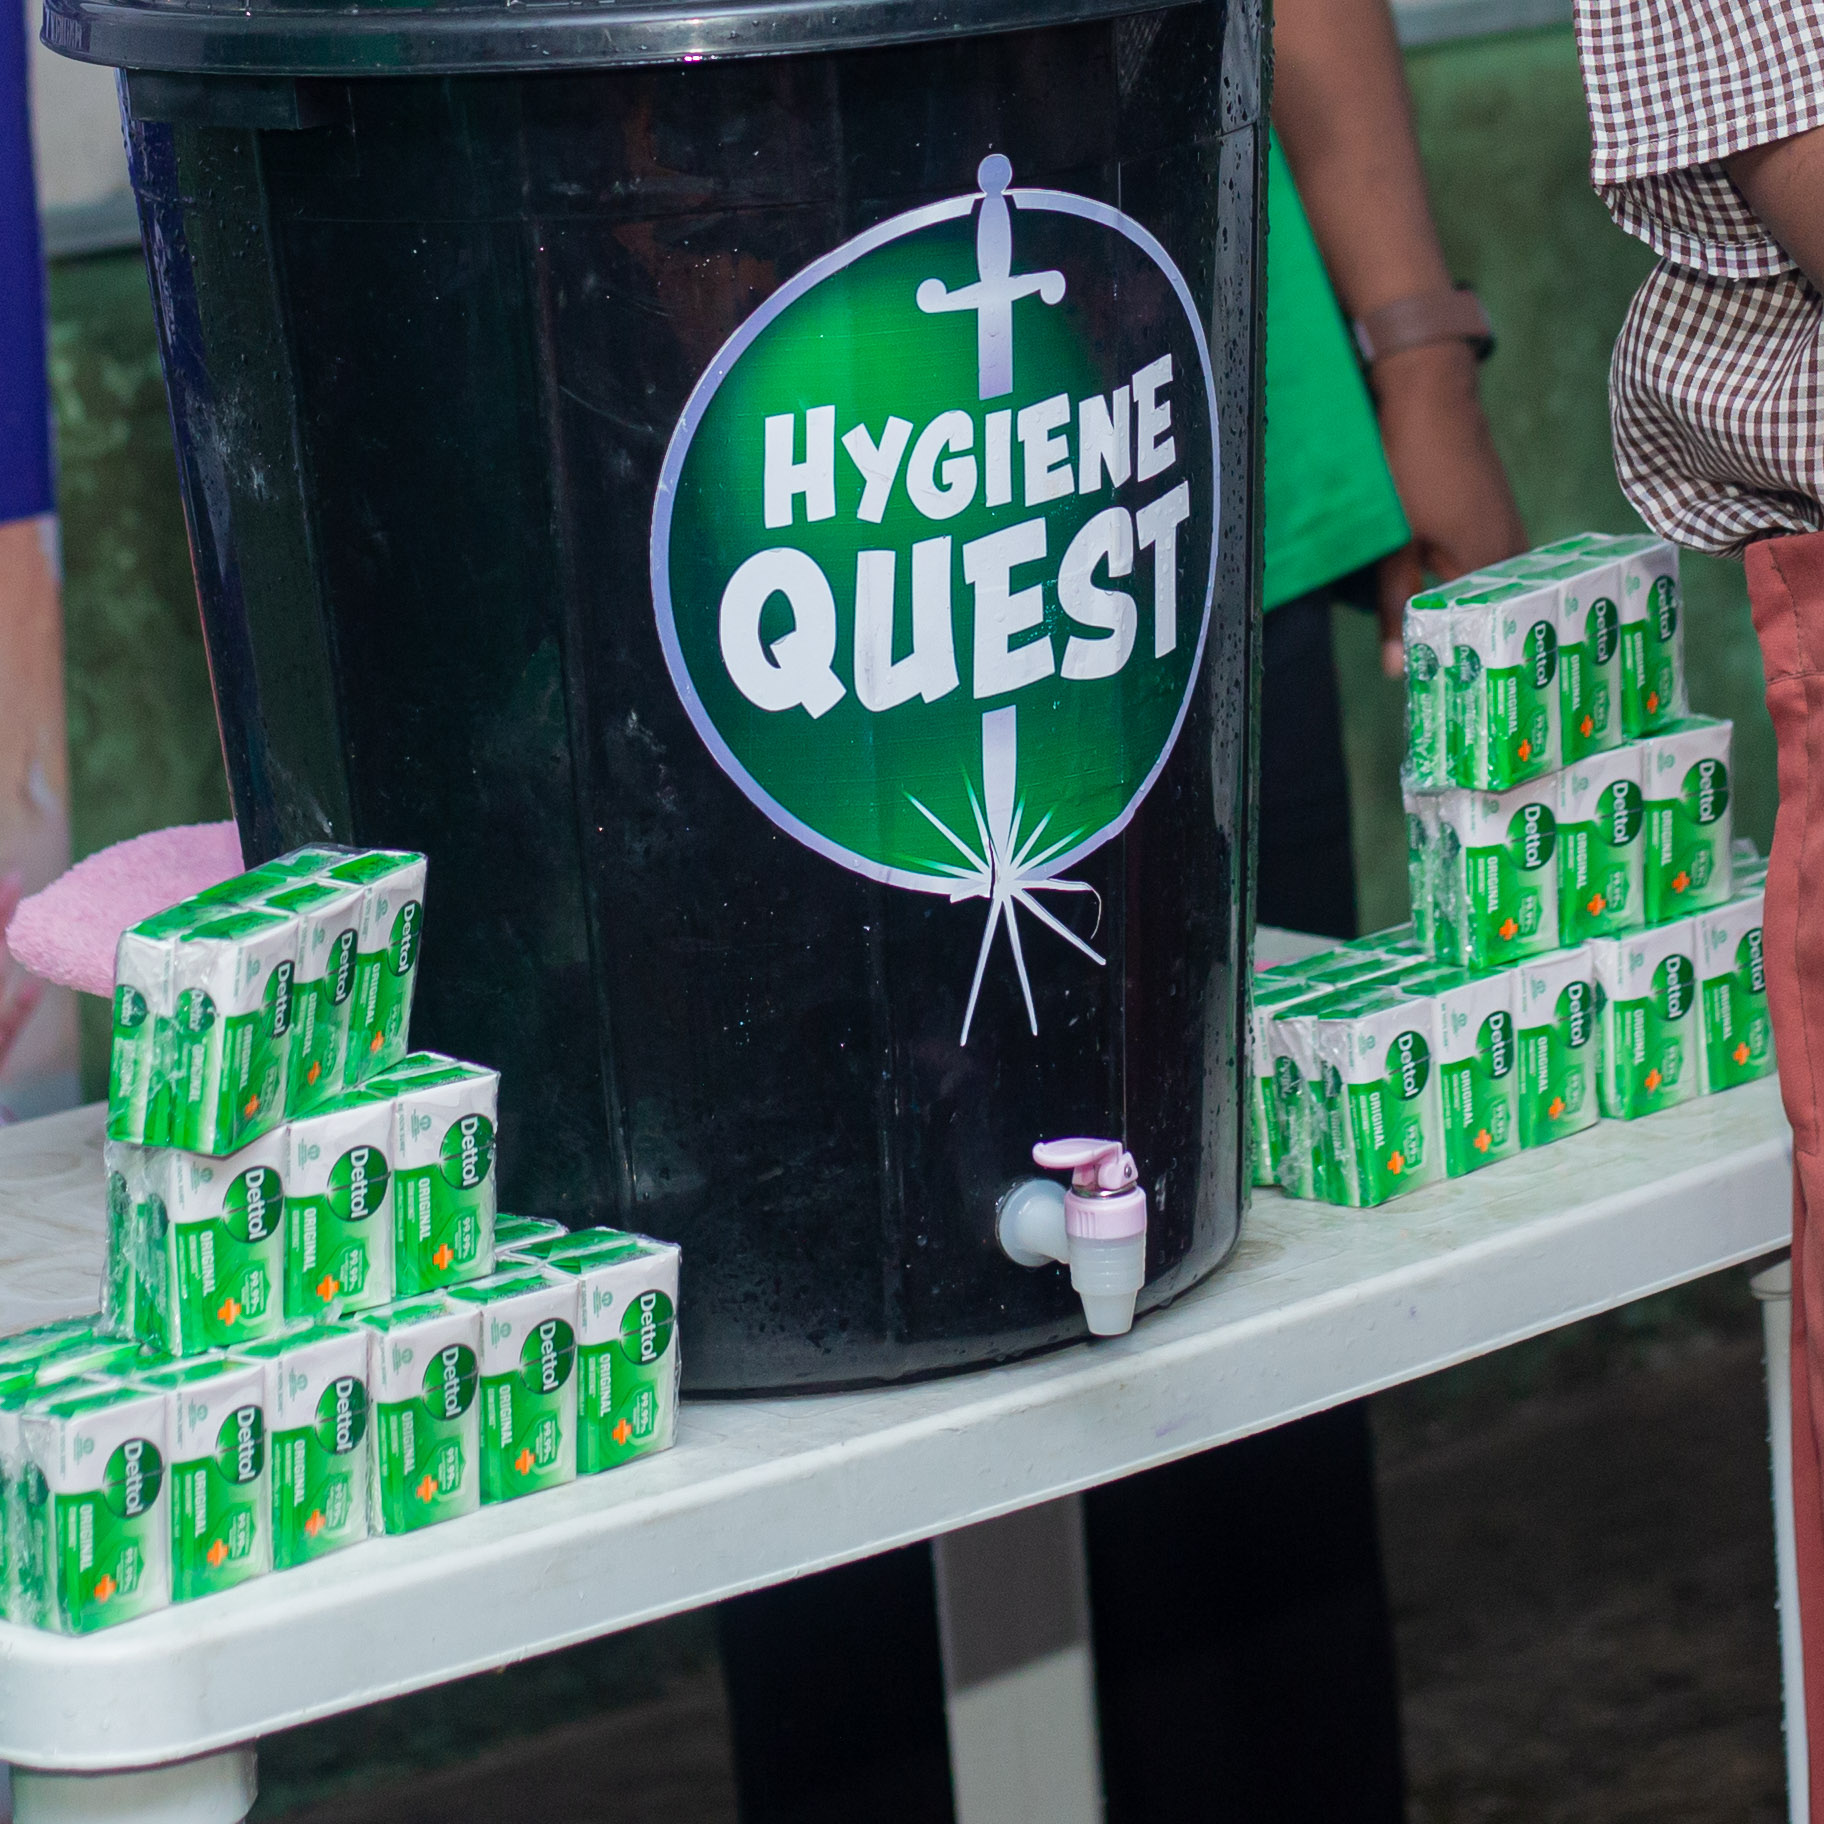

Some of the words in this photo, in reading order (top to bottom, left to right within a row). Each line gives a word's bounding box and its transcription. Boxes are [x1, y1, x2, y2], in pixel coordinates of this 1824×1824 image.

[762, 352, 1177, 530] HYGIENE
[717, 481, 1192, 720] QUEST
[1594, 600, 1609, 663] Dettol
[1657, 578, 1672, 640] Dettol
[1534, 623, 1548, 687] Dettol
[1507, 677, 1519, 737] ORIGINAL
[1613, 782, 1629, 844] Dettol
[1699, 760, 1716, 822] Dettol
[1524, 805, 1541, 868] Dettol
[1577, 832, 1588, 890] ORIGINAL
[1662, 809, 1673, 866] ORIGINAL
[1487, 856, 1499, 914] ORIGINAL
[336, 931, 354, 1003] Dettol
[398, 903, 416, 974] Dettol
[1748, 931, 1766, 992] Dettol
[274, 962, 292, 1039] Dettol
[365, 962, 381, 1027] ORIGINAL
[1568, 984, 1585, 1047] Dettol
[1666, 956, 1683, 1019] Dettol
[302, 992, 318, 1058] ORIGINAL
[1489, 1013, 1509, 1076] Dettol
[1633, 1009, 1646, 1066] ORIGINAL
[1398, 1034, 1418, 1098] Dettol
[1538, 1036, 1549, 1095] ORIGINAL
[1369, 1091, 1386, 1151] ORIGINAL
[1460, 1069, 1474, 1129] ORIGINAL
[350, 1146, 369, 1221] Dettol
[460, 1116, 480, 1188] Dettol
[245, 1168, 267, 1242] Dettol
[418, 1177, 431, 1241] ORIGINAL
[199, 1230, 216, 1297] ORIGINAL
[303, 1207, 318, 1272] ORIGINAL
[461, 1216, 471, 1259] 99.99%
[539, 1321, 559, 1392] Dettol
[640, 1293, 657, 1362] Dettol
[442, 1346, 462, 1417] Dettol
[599, 1353, 612, 1417] ORIGINAL
[237, 1408, 256, 1481] Dettol
[336, 1379, 354, 1452] Dettol
[401, 1410, 416, 1475] ORIGINAL
[498, 1384, 513, 1448] ORIGINAL
[124, 1440, 143, 1516] Dettol
[194, 1469, 207, 1538] ORIGINAL
[293, 1439, 306, 1507] ORIGINAL
[79, 1503, 94, 1573] ORIGINAL
